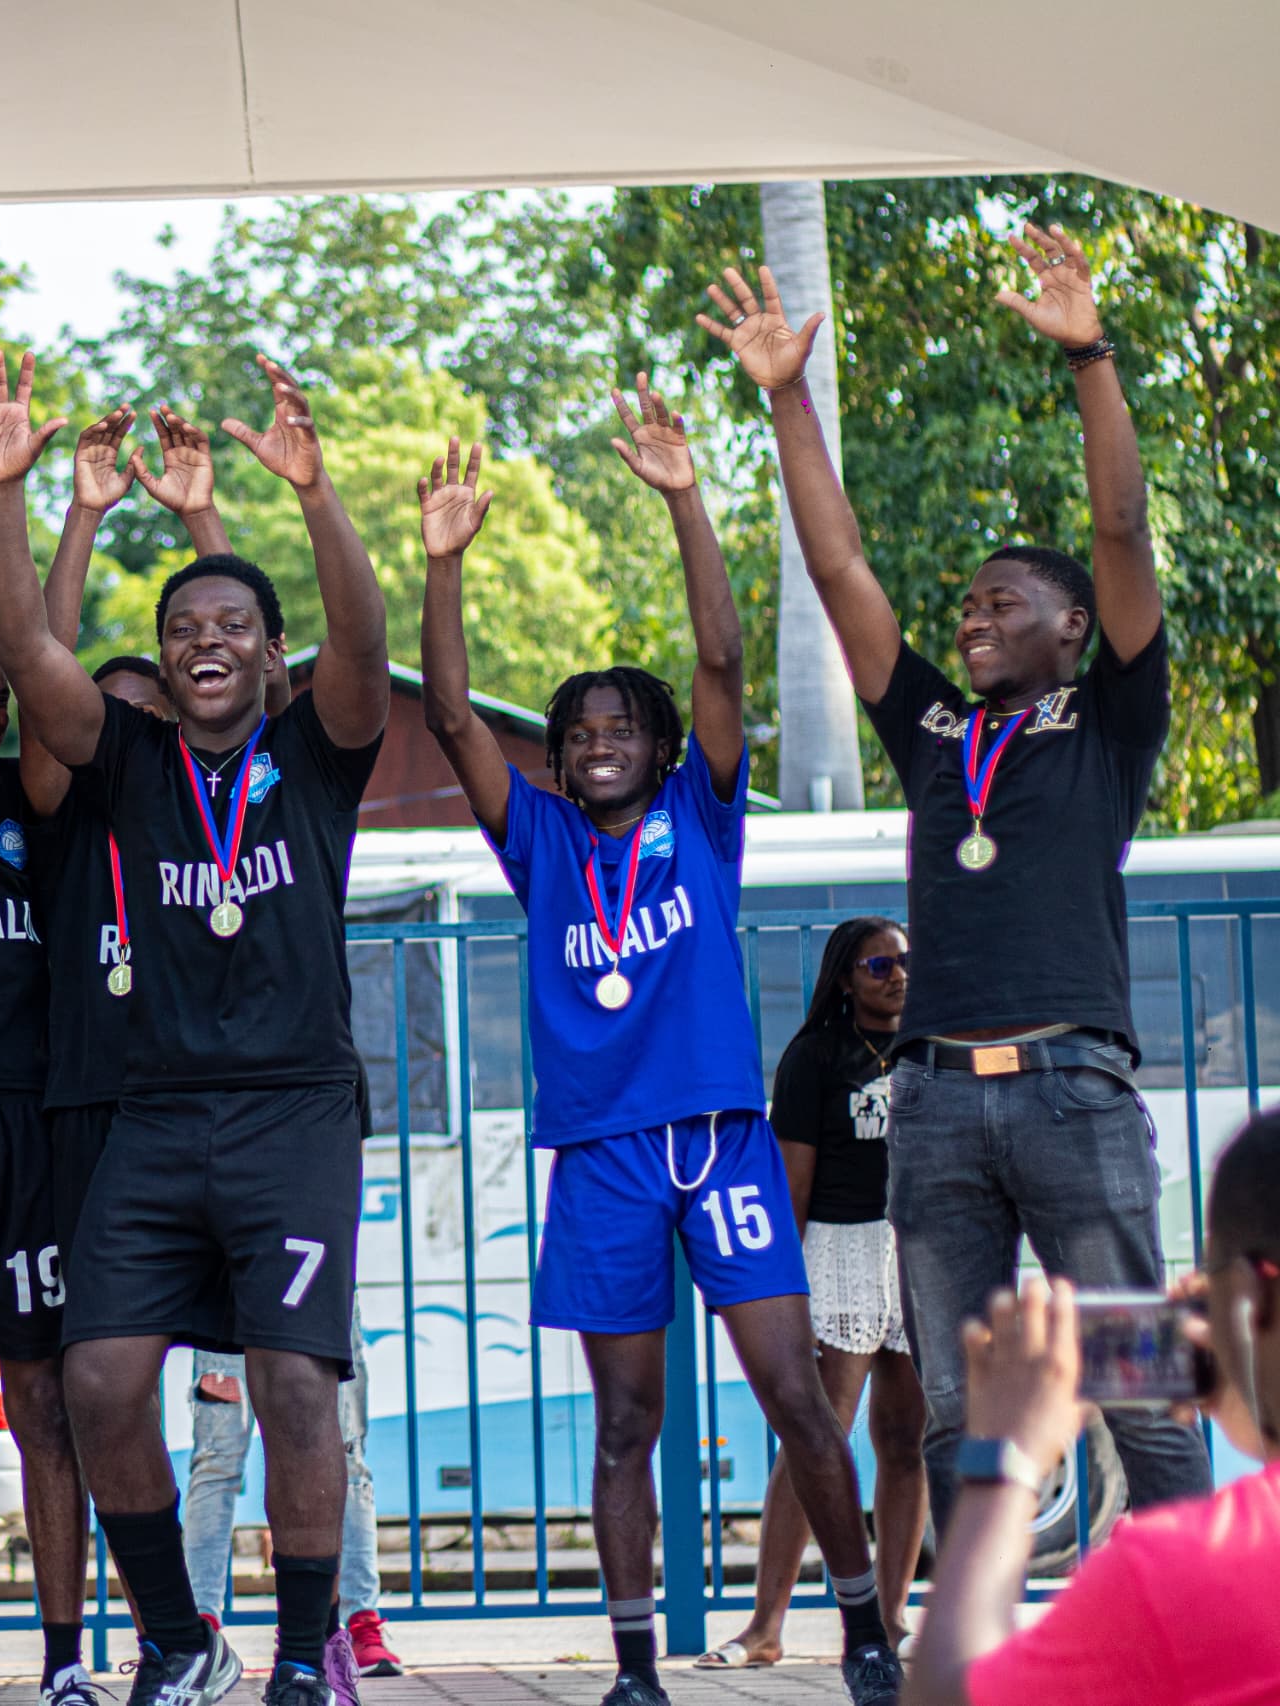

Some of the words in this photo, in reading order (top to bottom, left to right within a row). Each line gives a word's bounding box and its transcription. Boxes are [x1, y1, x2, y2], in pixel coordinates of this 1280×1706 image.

[159, 840, 295, 907] RINALDI
[702, 1185, 772, 1257] 15
[6, 1245, 66, 1312] 19
[282, 1238, 325, 1306] 7
